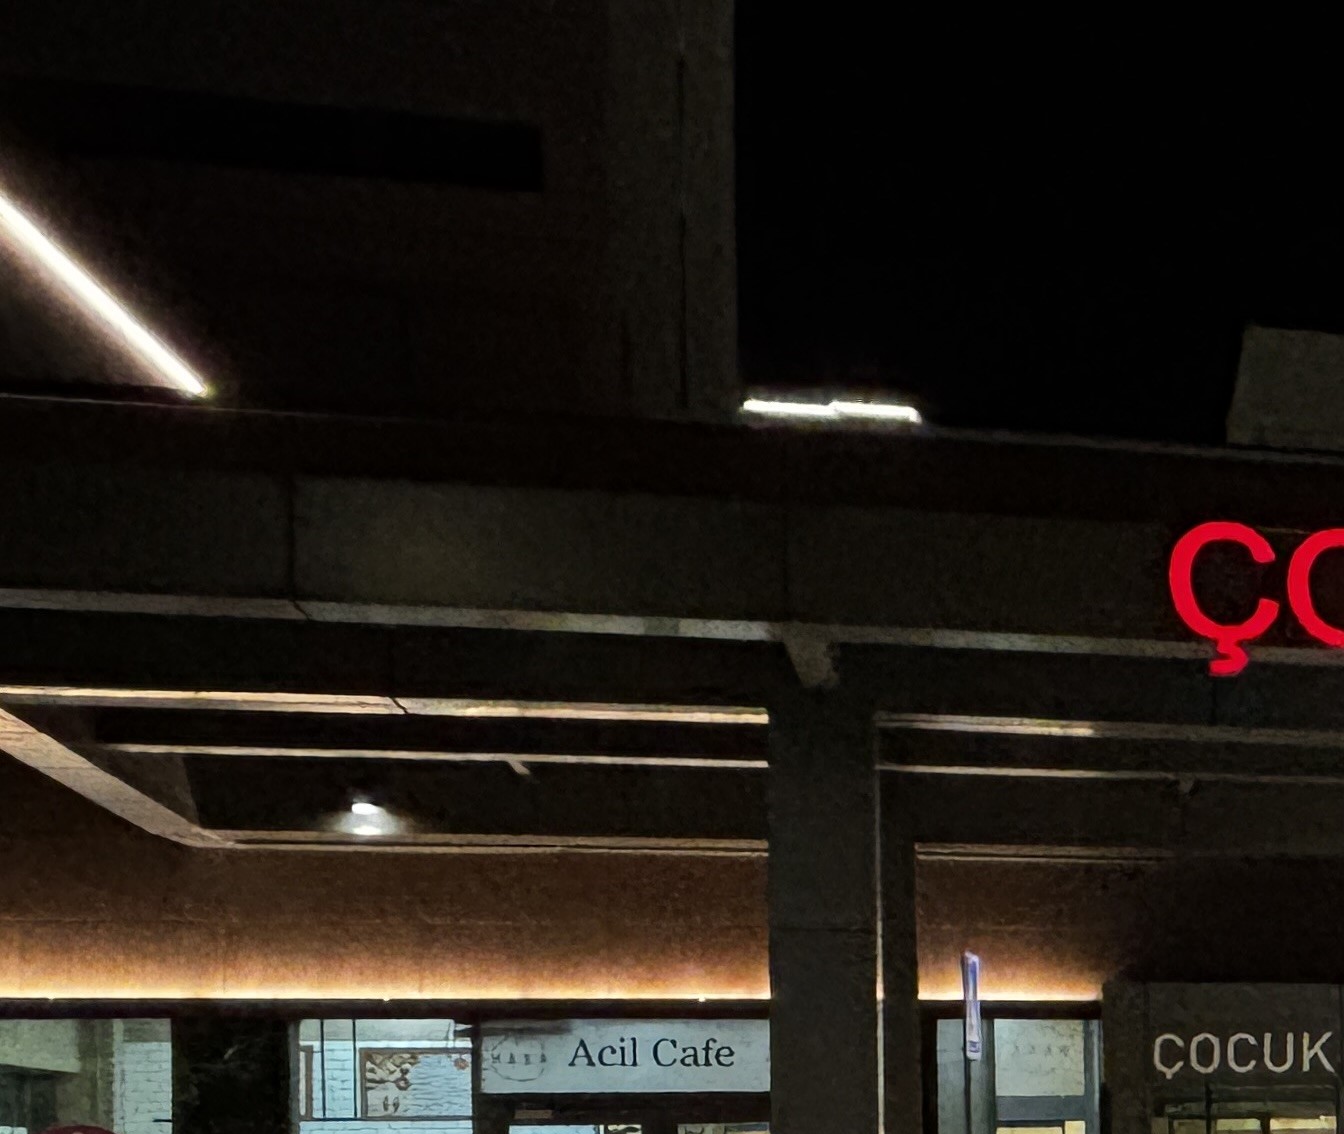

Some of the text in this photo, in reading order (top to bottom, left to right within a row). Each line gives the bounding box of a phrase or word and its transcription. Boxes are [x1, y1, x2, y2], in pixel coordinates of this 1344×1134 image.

[568, 1037, 638, 1067] Acil
[652, 1037, 735, 1067] Cafe
[1153, 1031, 1336, 1080] ÇOCUK
